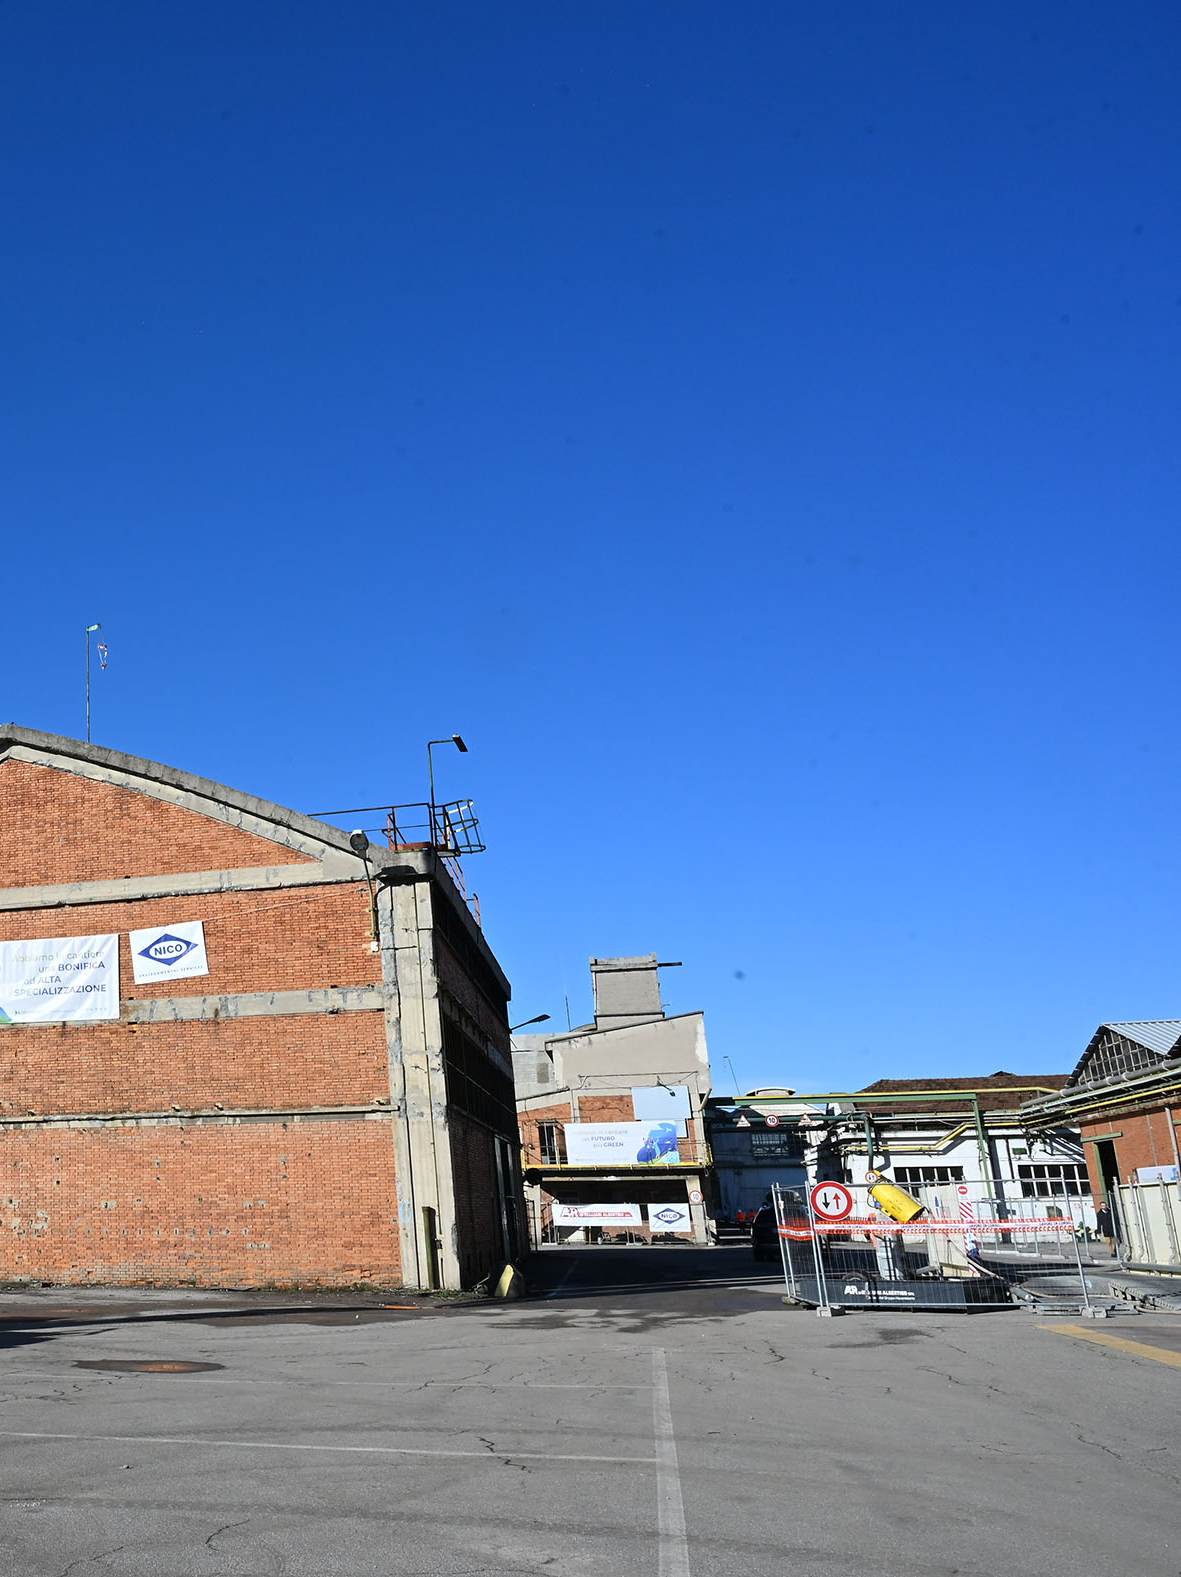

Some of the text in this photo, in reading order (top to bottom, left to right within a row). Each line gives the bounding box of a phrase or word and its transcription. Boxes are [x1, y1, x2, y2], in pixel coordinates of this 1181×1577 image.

[154, 943, 183, 956] NICO
[58, 961, 106, 972] BONIFICA
[37, 975, 62, 984] ALTA
[14, 984, 107, 997] SPECIALIZZAZIONE
